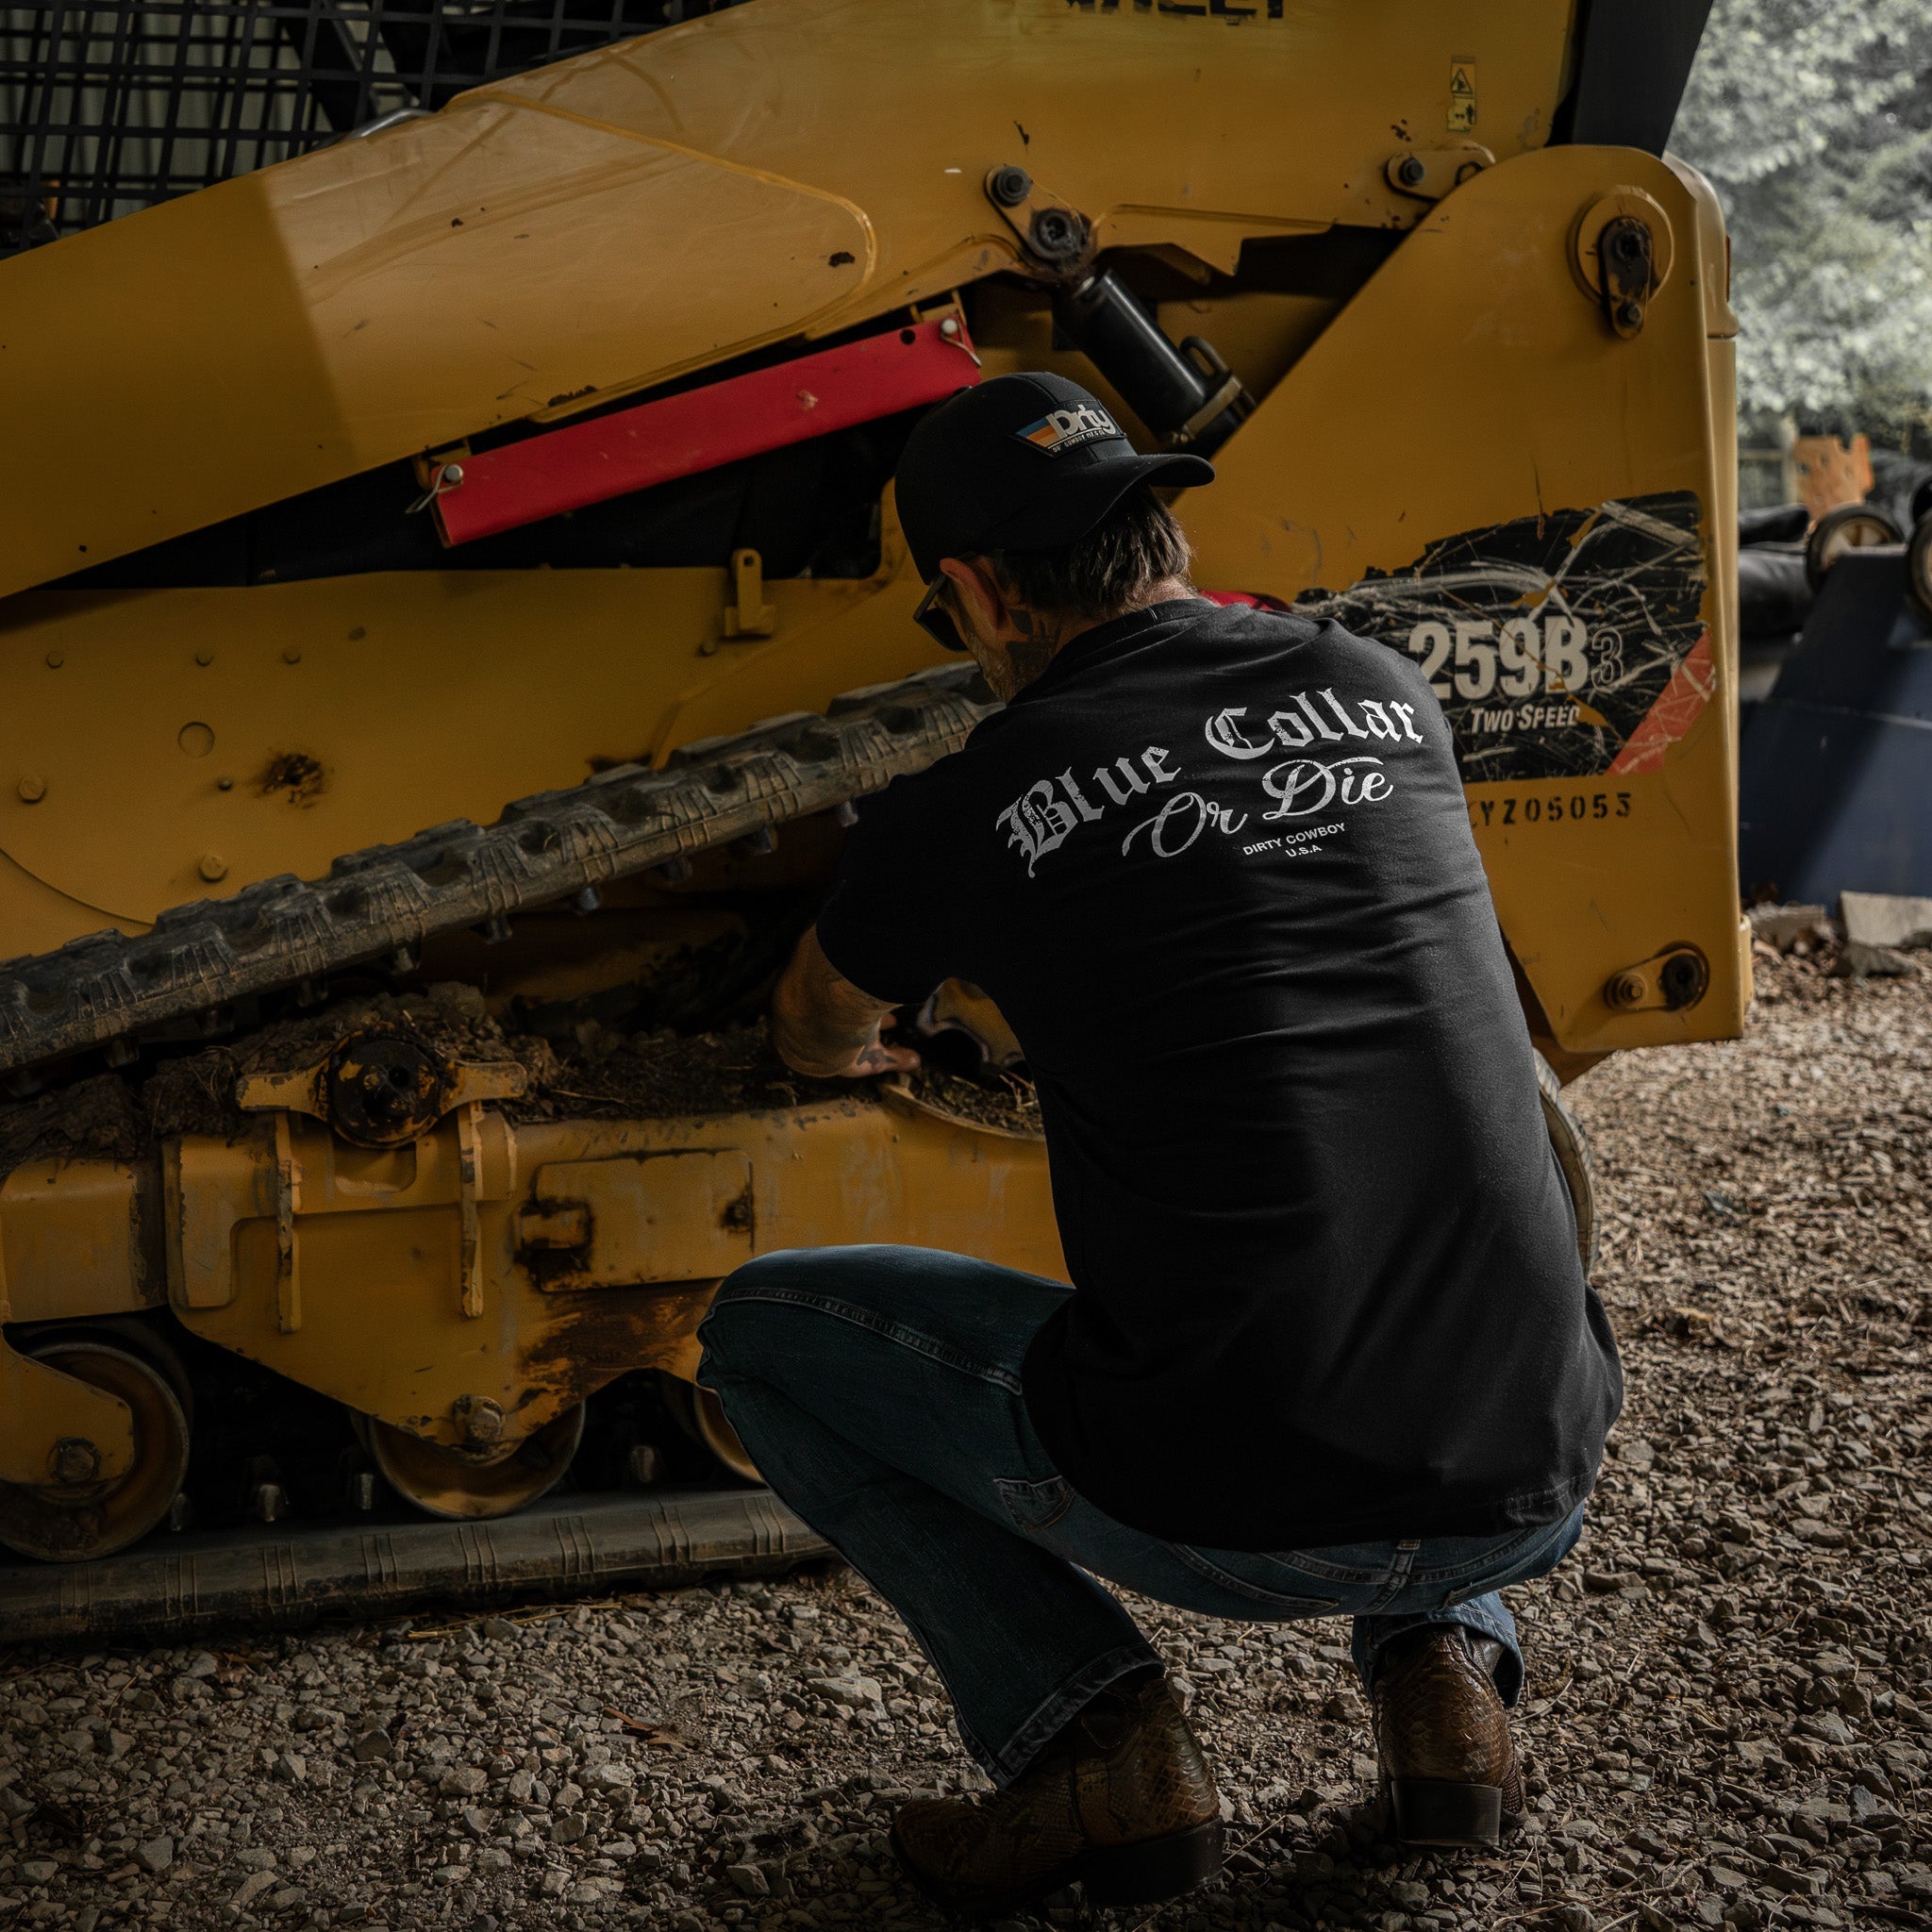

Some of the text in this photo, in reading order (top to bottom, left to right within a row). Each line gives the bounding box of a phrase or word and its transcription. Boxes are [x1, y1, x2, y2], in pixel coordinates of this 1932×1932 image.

[995, 687, 1424, 878] Blue Collar
[1122, 756, 1393, 858] Or Die
[1242, 823, 1345, 855] DIRTY COWBOY
[1285, 844, 1323, 858] U.S.A
